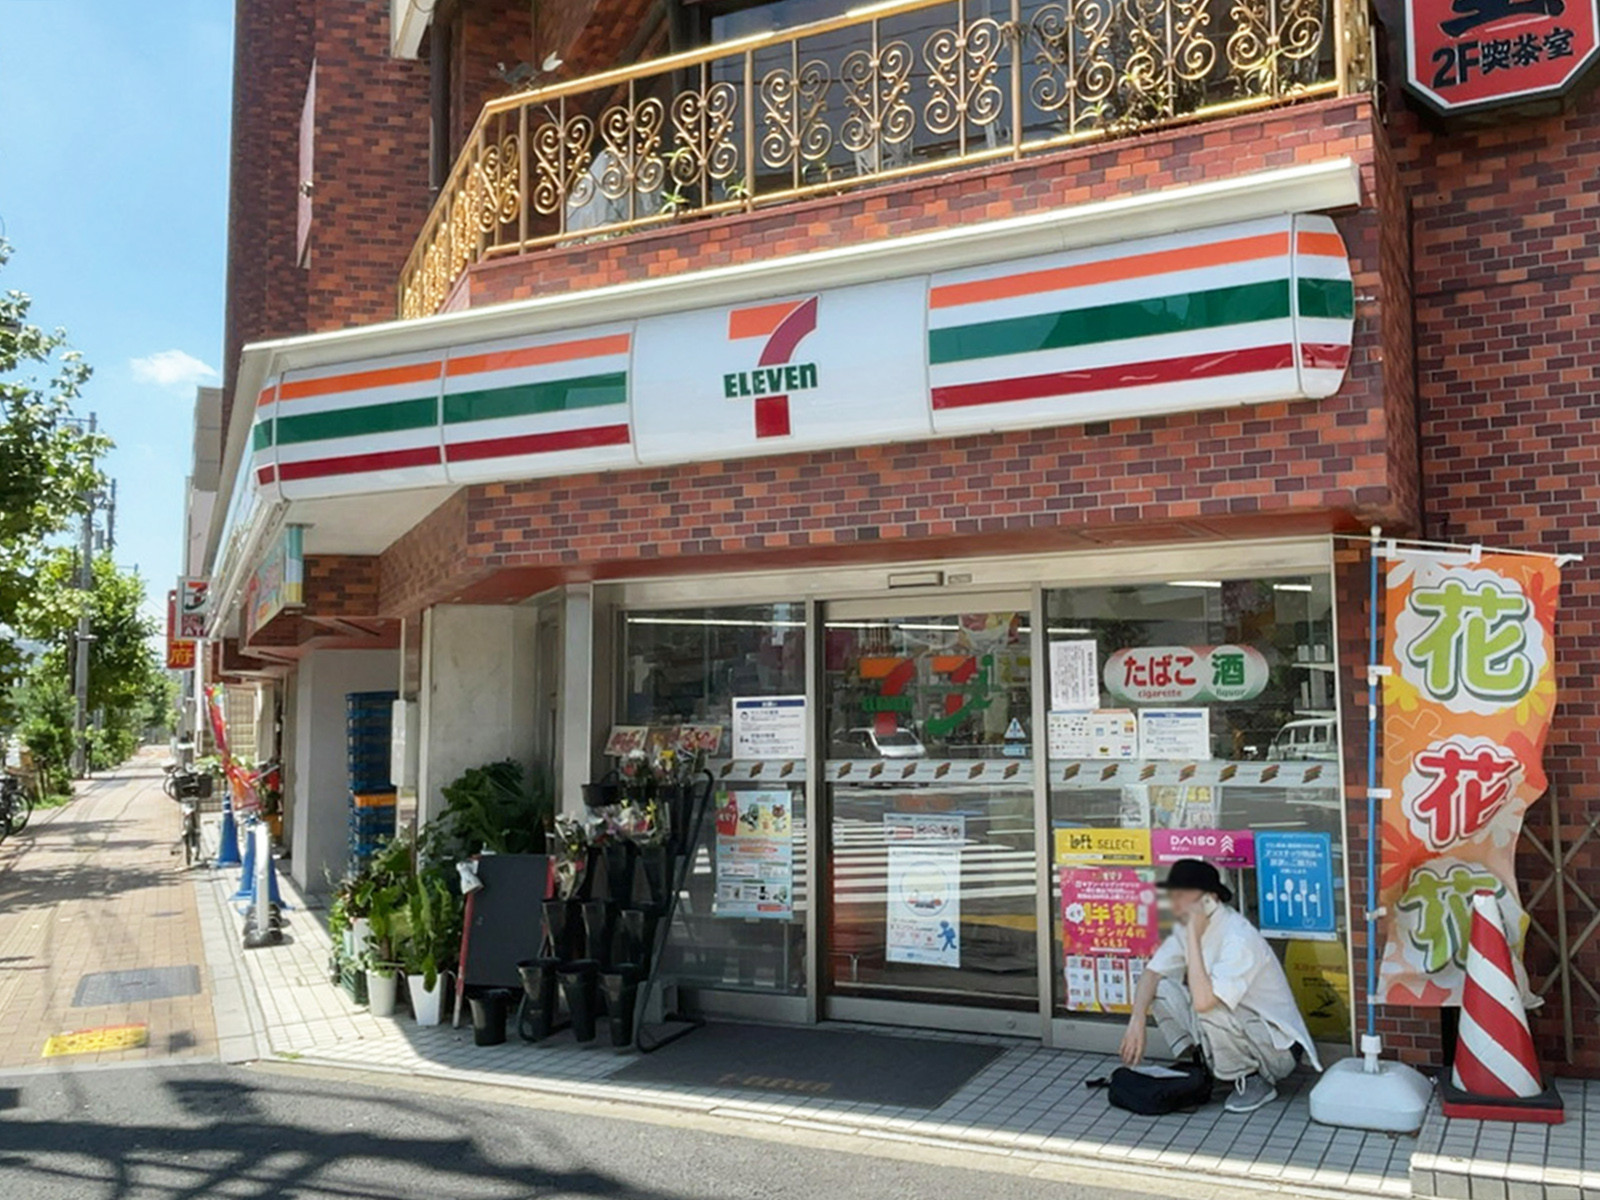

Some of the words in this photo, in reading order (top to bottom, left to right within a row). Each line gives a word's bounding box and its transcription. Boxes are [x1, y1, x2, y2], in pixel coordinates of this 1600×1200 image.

[1432, 27, 1575, 89] 2F喫茶室
[728, 295, 819, 439] 7
[1123, 653, 1197, 688] たばこ
[1211, 652, 1245, 687] 酒
[1138, 689, 1183, 700] cigarette
[1216, 688, 1246, 699] liquor
[1097, 838, 1135, 850] SELECT
[1170, 835, 1217, 846] DAISO
